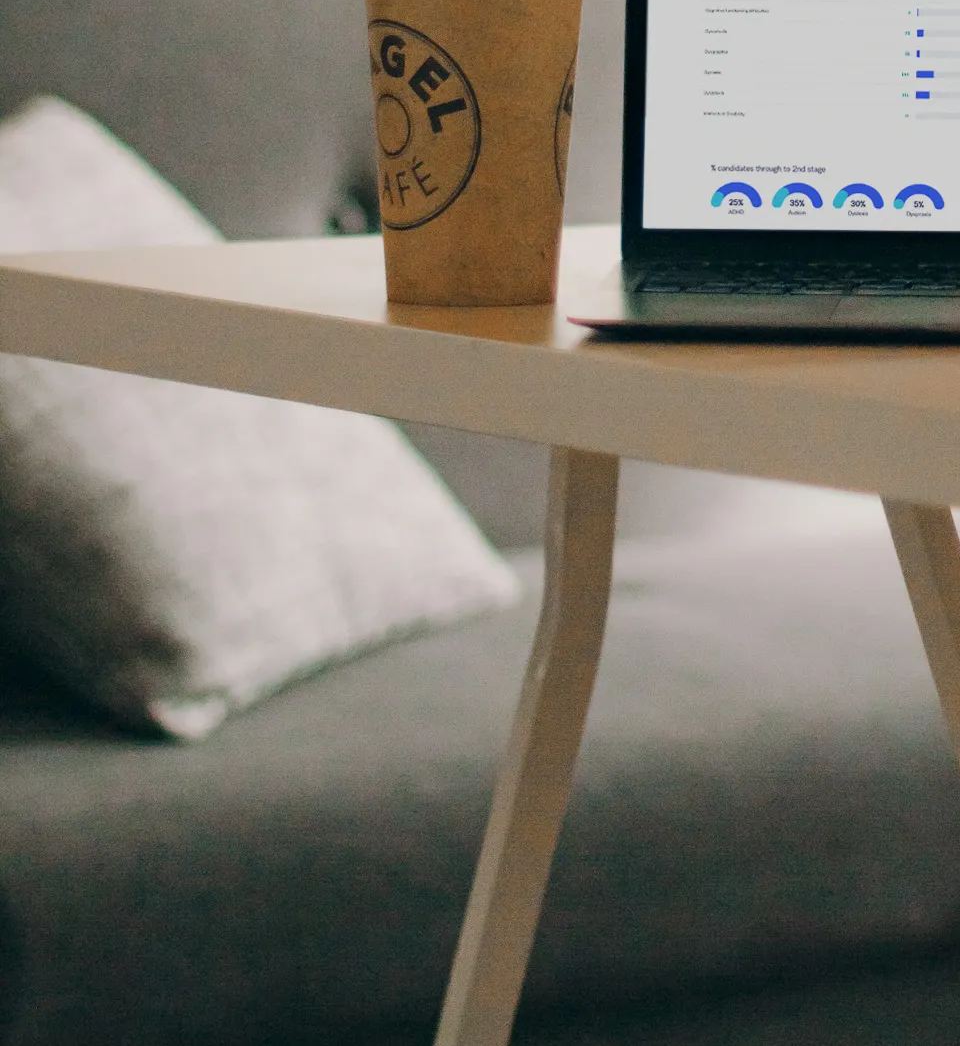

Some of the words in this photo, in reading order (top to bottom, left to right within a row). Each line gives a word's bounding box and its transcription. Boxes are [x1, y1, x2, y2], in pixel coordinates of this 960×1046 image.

[373, 35, 467, 134] GEL
[711, 164, 717, 172] %
[755, 165, 782, 174] through
[792, 165, 806, 173] 2nd
[807, 166, 827, 174] stage
[728, 198, 744, 206] 25%
[789, 199, 805, 207] 35%
[850, 200, 866, 208] 30%
[913, 200, 924, 208] 5%
